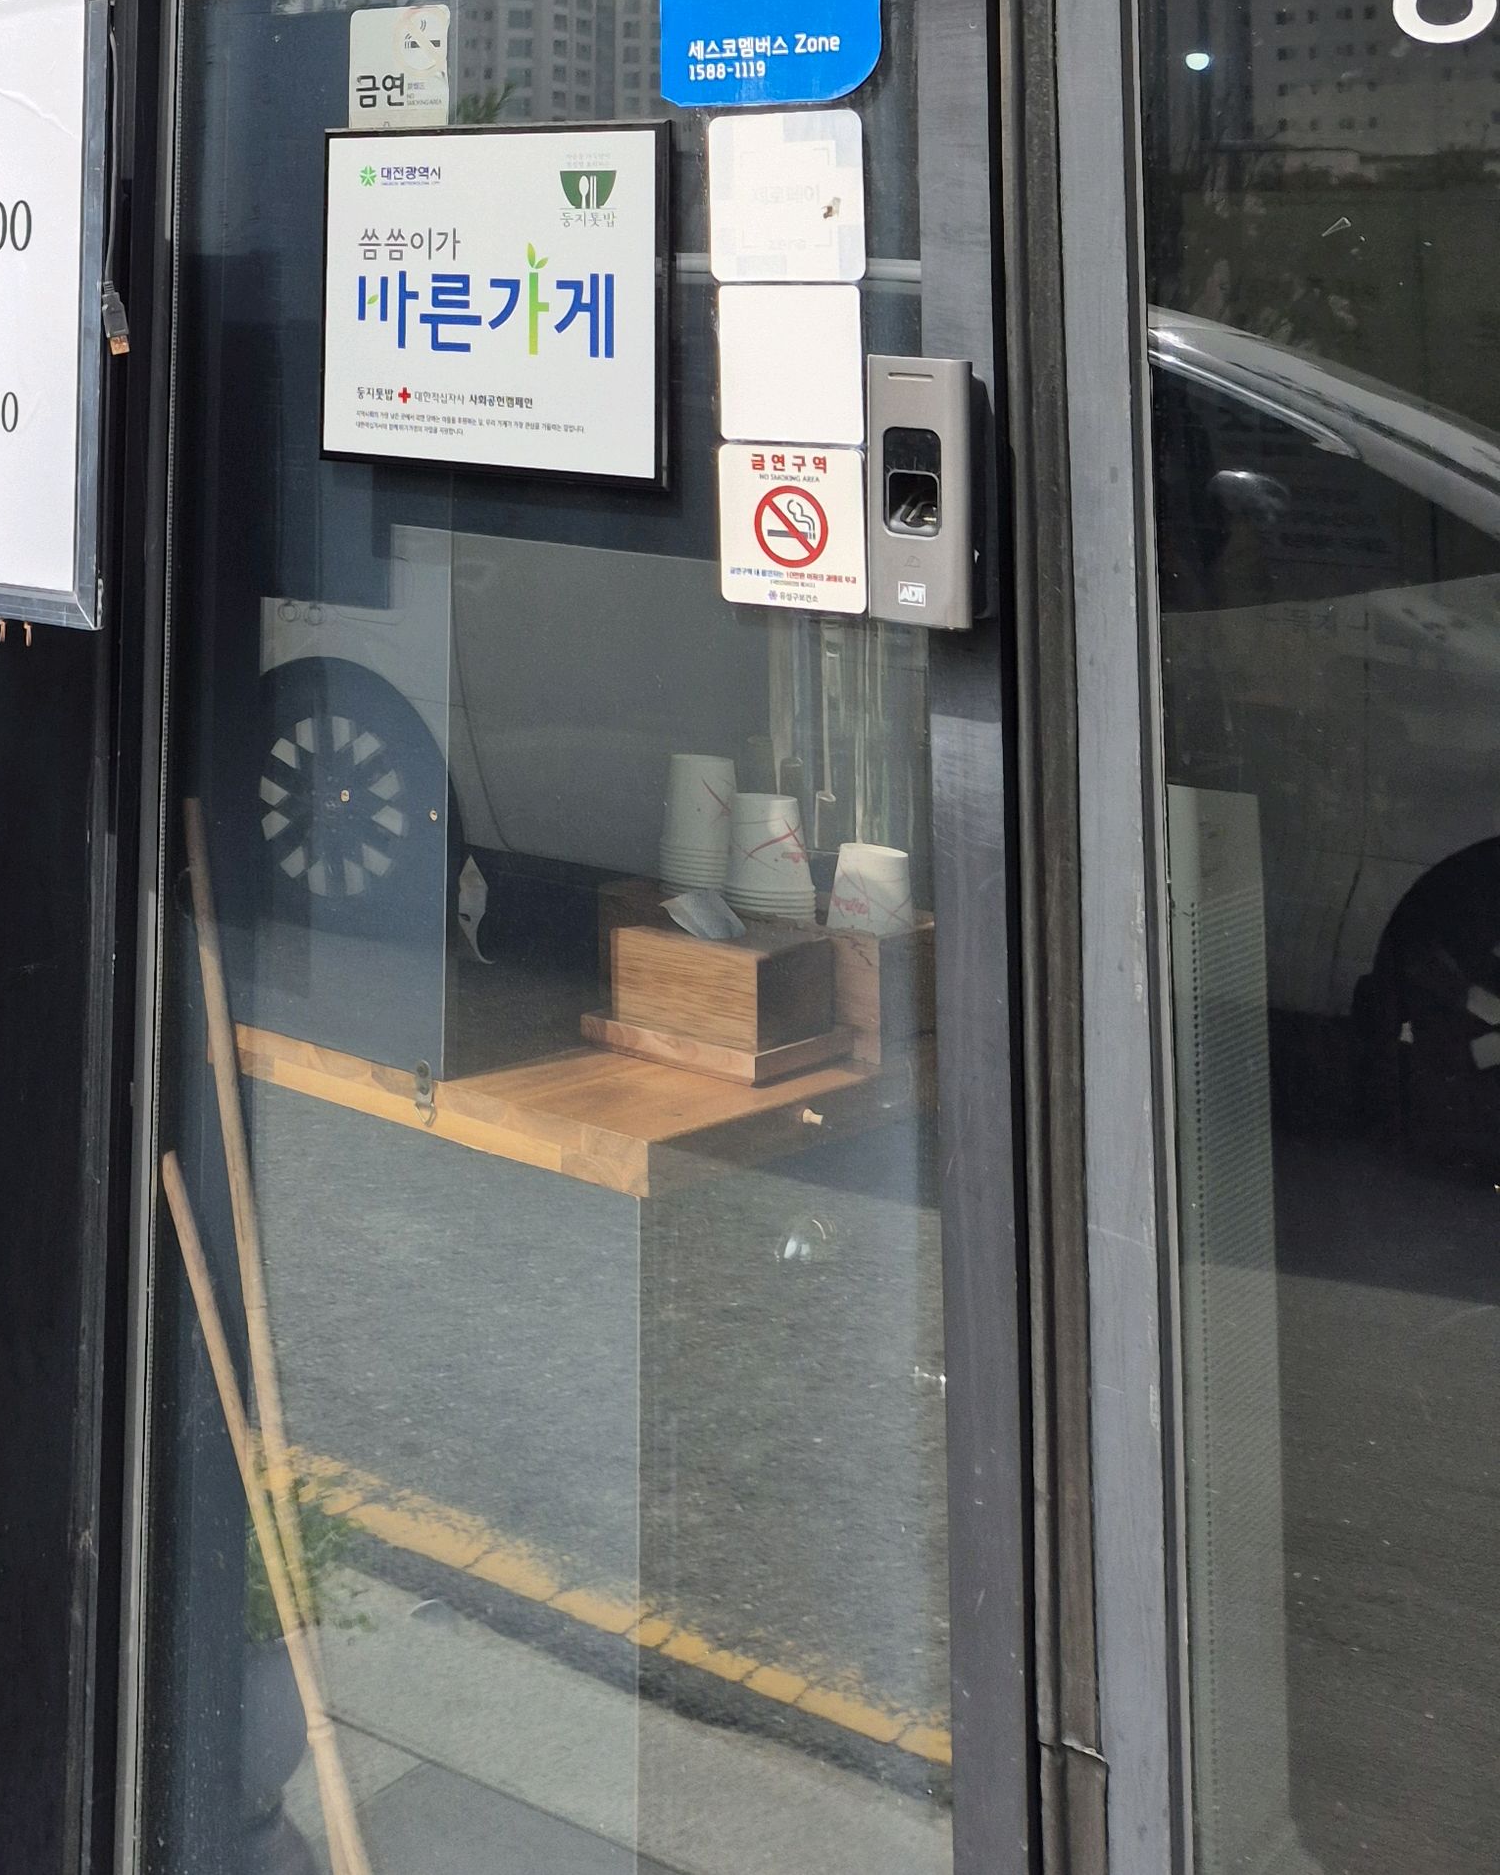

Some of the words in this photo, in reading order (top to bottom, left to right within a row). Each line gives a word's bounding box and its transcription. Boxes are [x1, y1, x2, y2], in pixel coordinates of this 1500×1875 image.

[688, 35, 789, 61] 세스코멤버스
[794, 33, 841, 54] Zone
[688, 60, 767, 81] 1588-1119
[355, 72, 405, 109] 금연
[381, 166, 442, 181] 대전광역시
[358, 227, 462, 262] 씀씀이가
[357, 269, 616, 359] 바른가게
[751, 453, 827, 474] 금연구역
[899, 585, 924, 603] ADT
